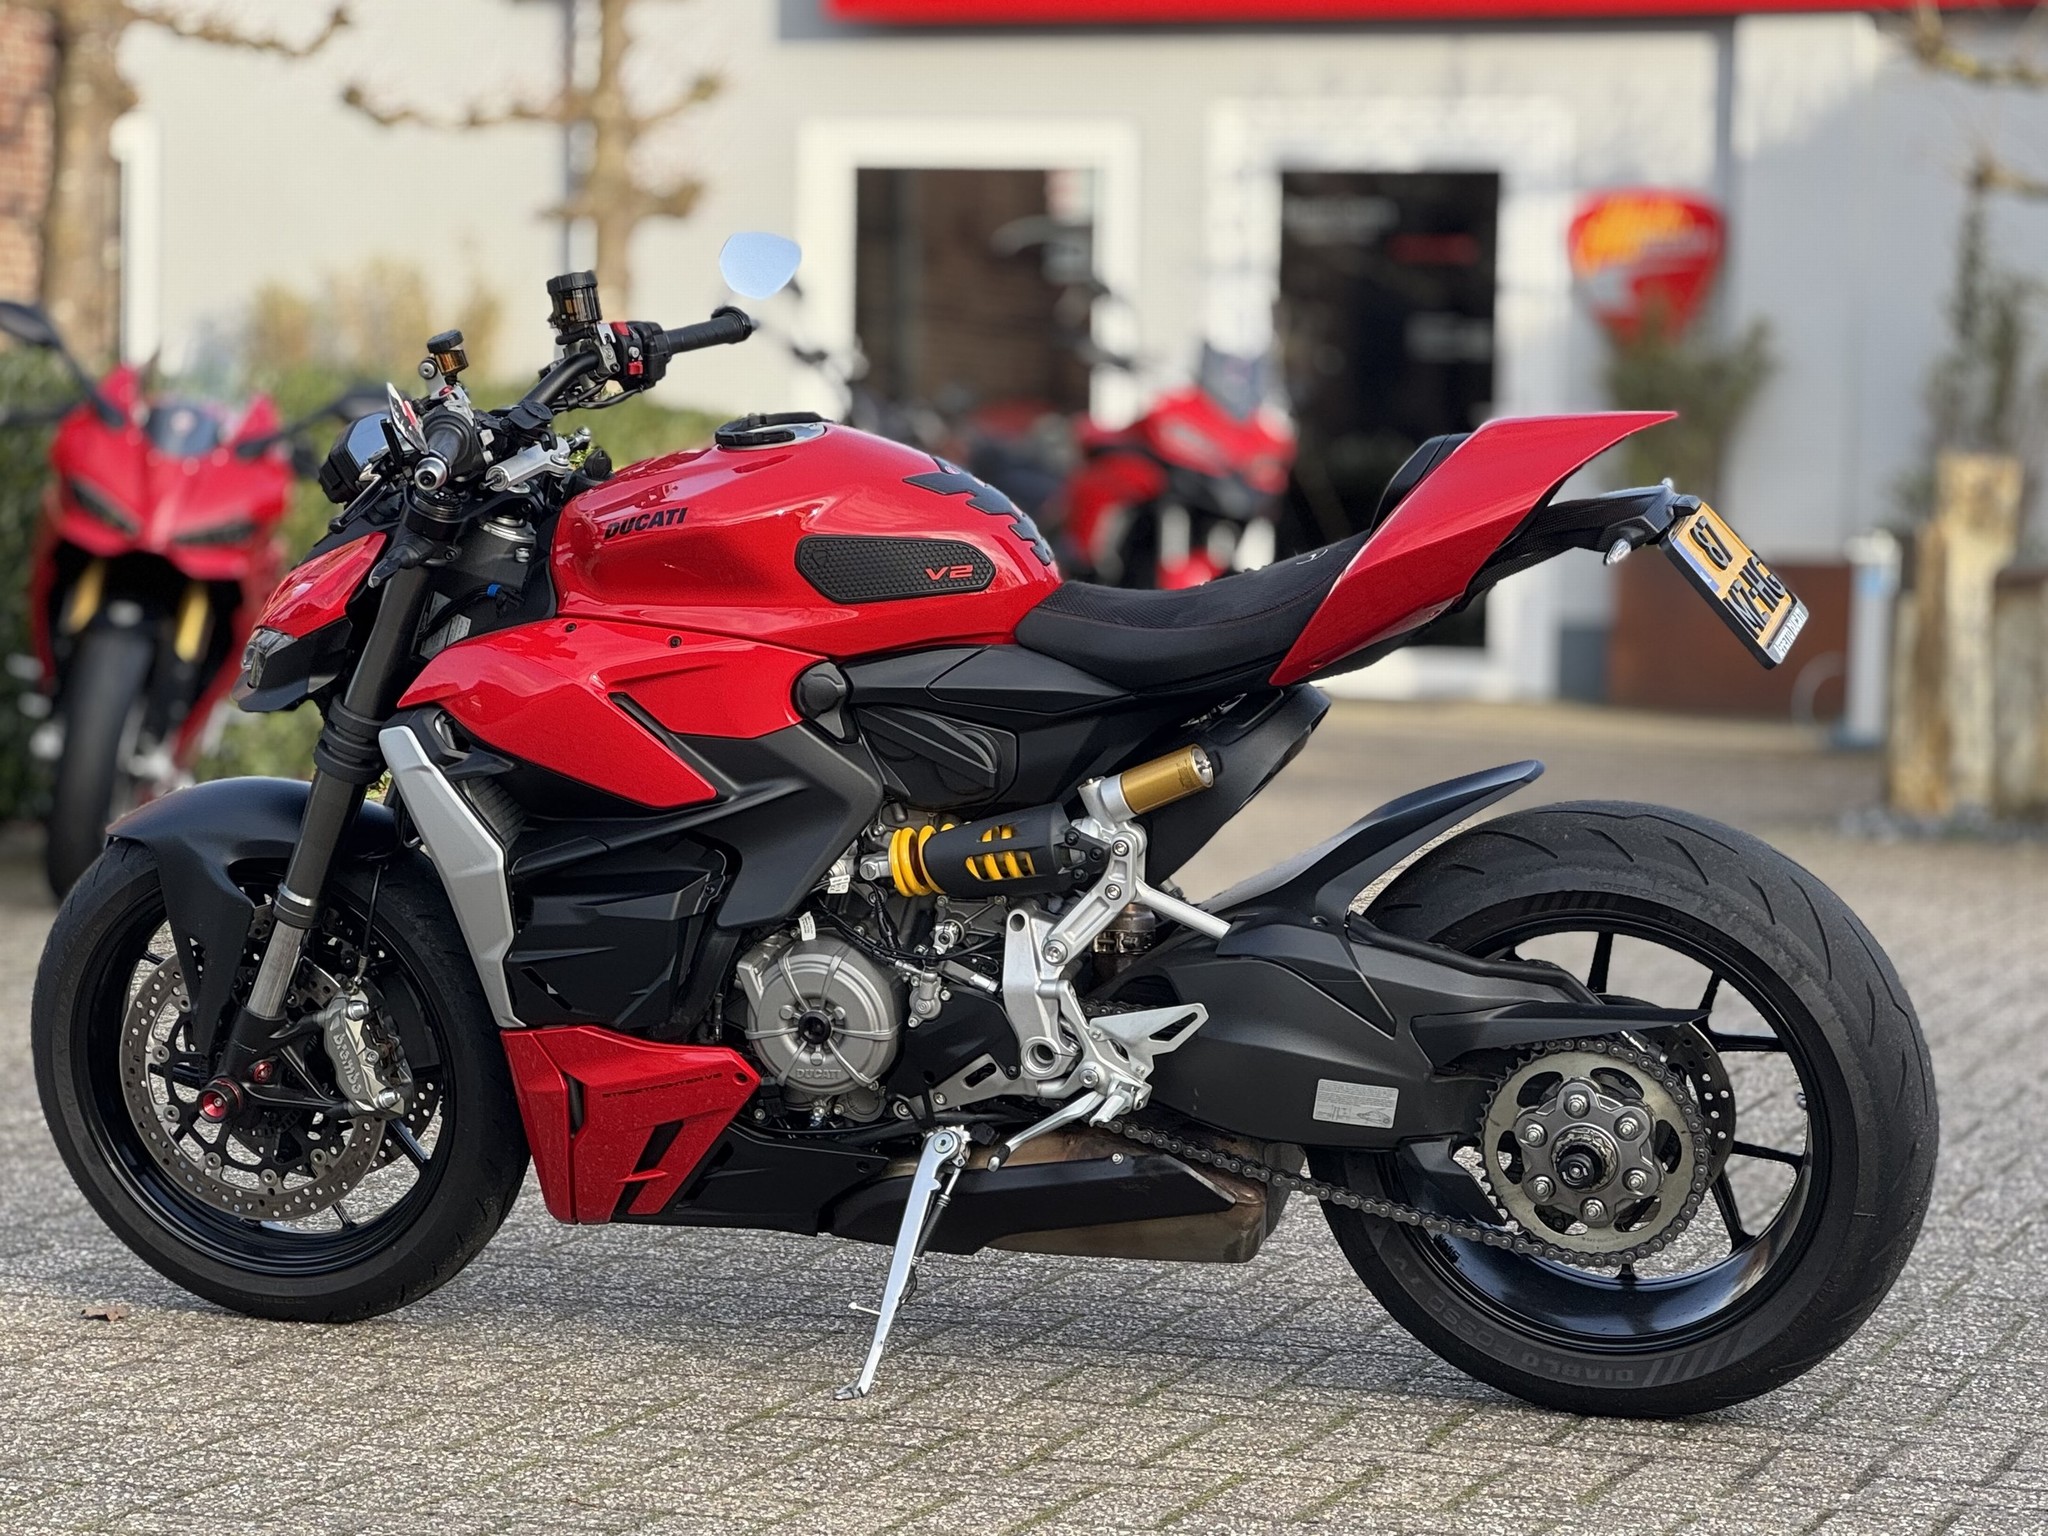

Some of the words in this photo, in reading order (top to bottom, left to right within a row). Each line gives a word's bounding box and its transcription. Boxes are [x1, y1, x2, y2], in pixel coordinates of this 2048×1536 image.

[603, 506, 689, 540] DUCATI
[1689, 515, 1734, 571] 87
[924, 563, 974, 582] V2
[332, 1032, 362, 1095] brembo
[796, 1068, 842, 1080] DUCATI
[1520, 1353, 1635, 1382] DIABLO
